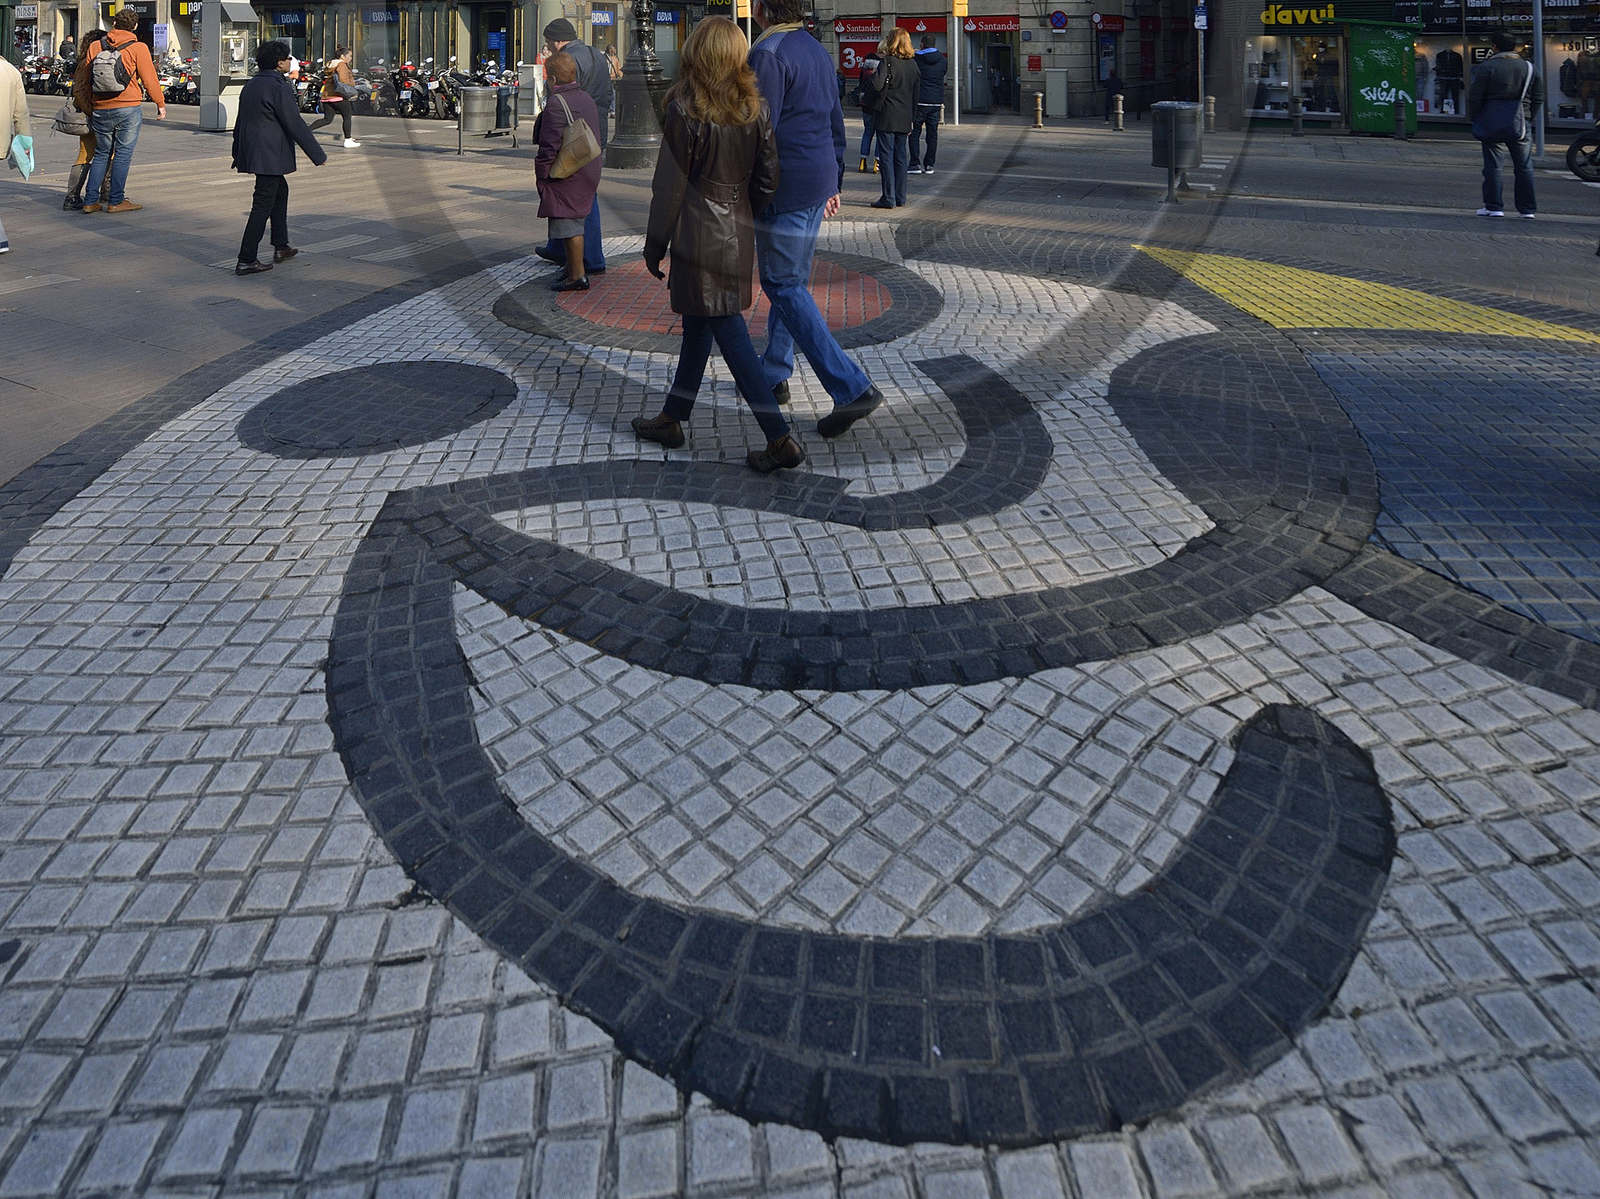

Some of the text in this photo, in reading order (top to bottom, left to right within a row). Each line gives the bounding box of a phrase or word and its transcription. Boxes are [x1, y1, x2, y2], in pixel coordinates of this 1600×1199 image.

[281, 14, 300, 24] BBVA
[372, 11, 394, 22] BBVA
[592, 12, 611, 24] BBVA
[656, 11, 673, 22] BBVA
[846, 22, 881, 33] Santander
[978, 20, 1020, 31] Santander
